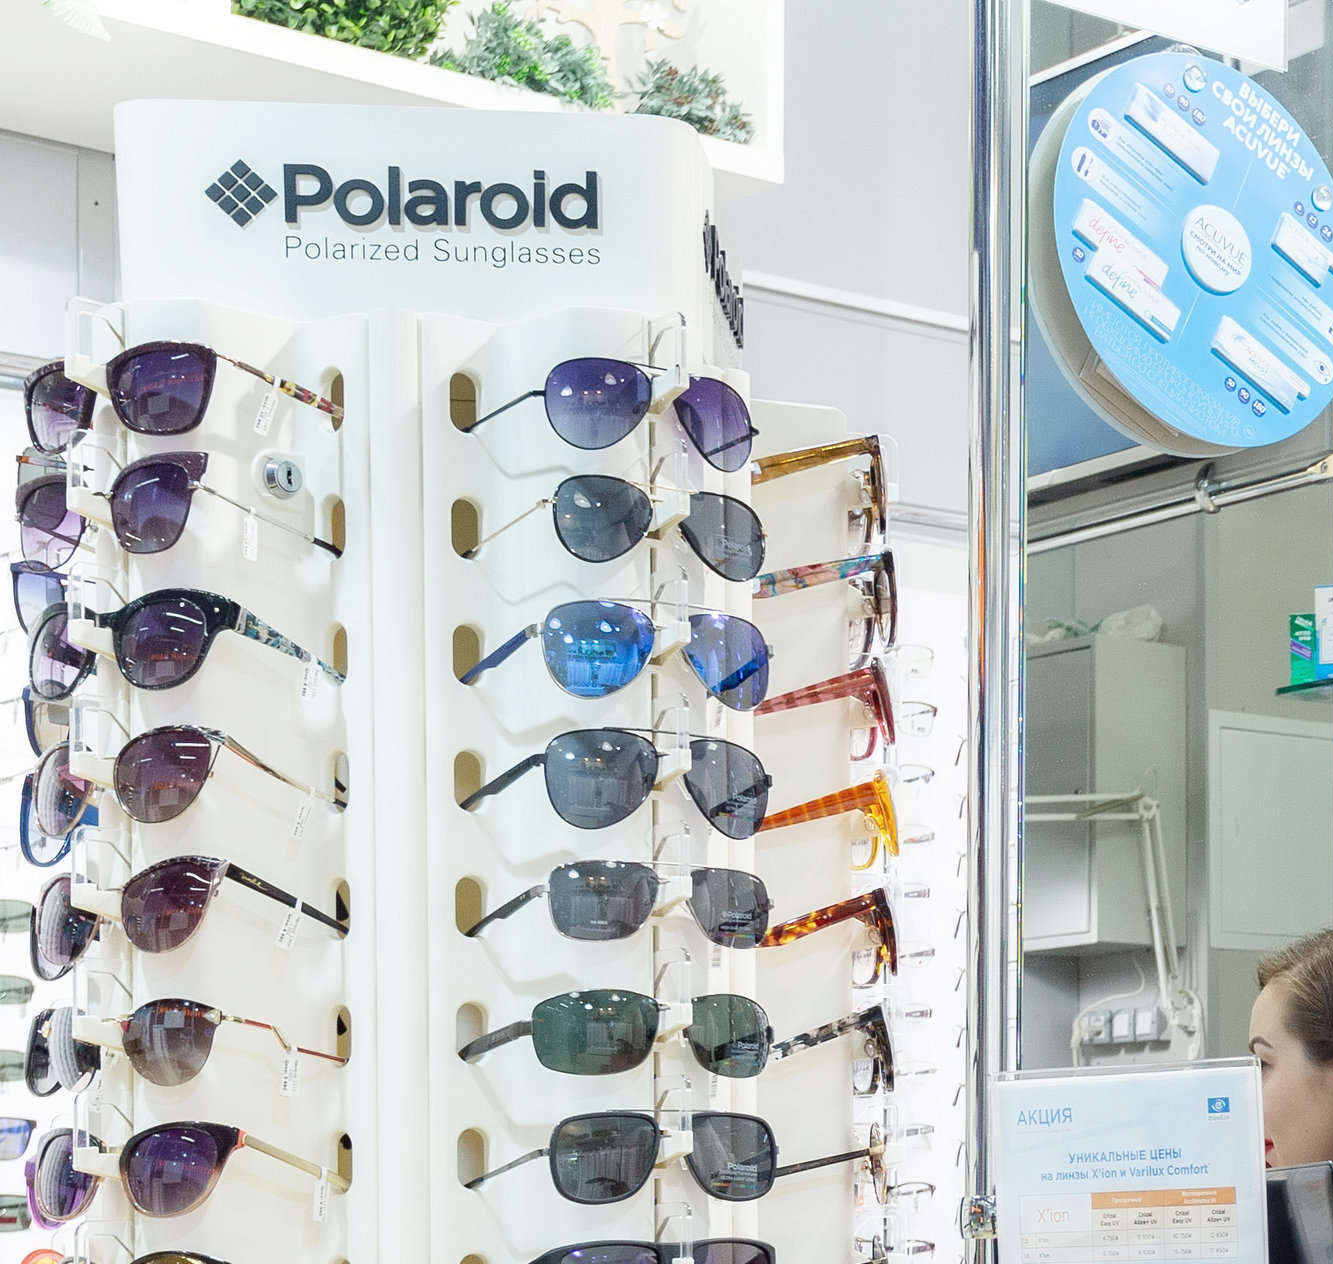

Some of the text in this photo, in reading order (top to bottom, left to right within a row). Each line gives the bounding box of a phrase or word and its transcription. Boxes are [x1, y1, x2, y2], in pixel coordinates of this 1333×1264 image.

[1212, 80, 1314, 182] СВОИ ЛИНЗЫ
[1239, 82, 1300, 146] ВЫБЕРИ
[1222, 116, 1289, 180] ACUVUE
[283, 162, 601, 230] Polaroid
[284, 236, 602, 269] Polarized Sunglasses
[1195, 217, 1247, 264] ACUVUE
[1017, 1108, 1072, 1127] АКЦИЯ
[1041, 1172, 1053, 1181] на
[1056, 1171, 1089, 1181] линзы
[1130, 1166, 1164, 1176] Varilux
[1167, 1163, 1209, 1175] Comfort
[1068, 1148, 1181, 1164] УНИКАЛЬНЫЕ ЦЕНЫ
